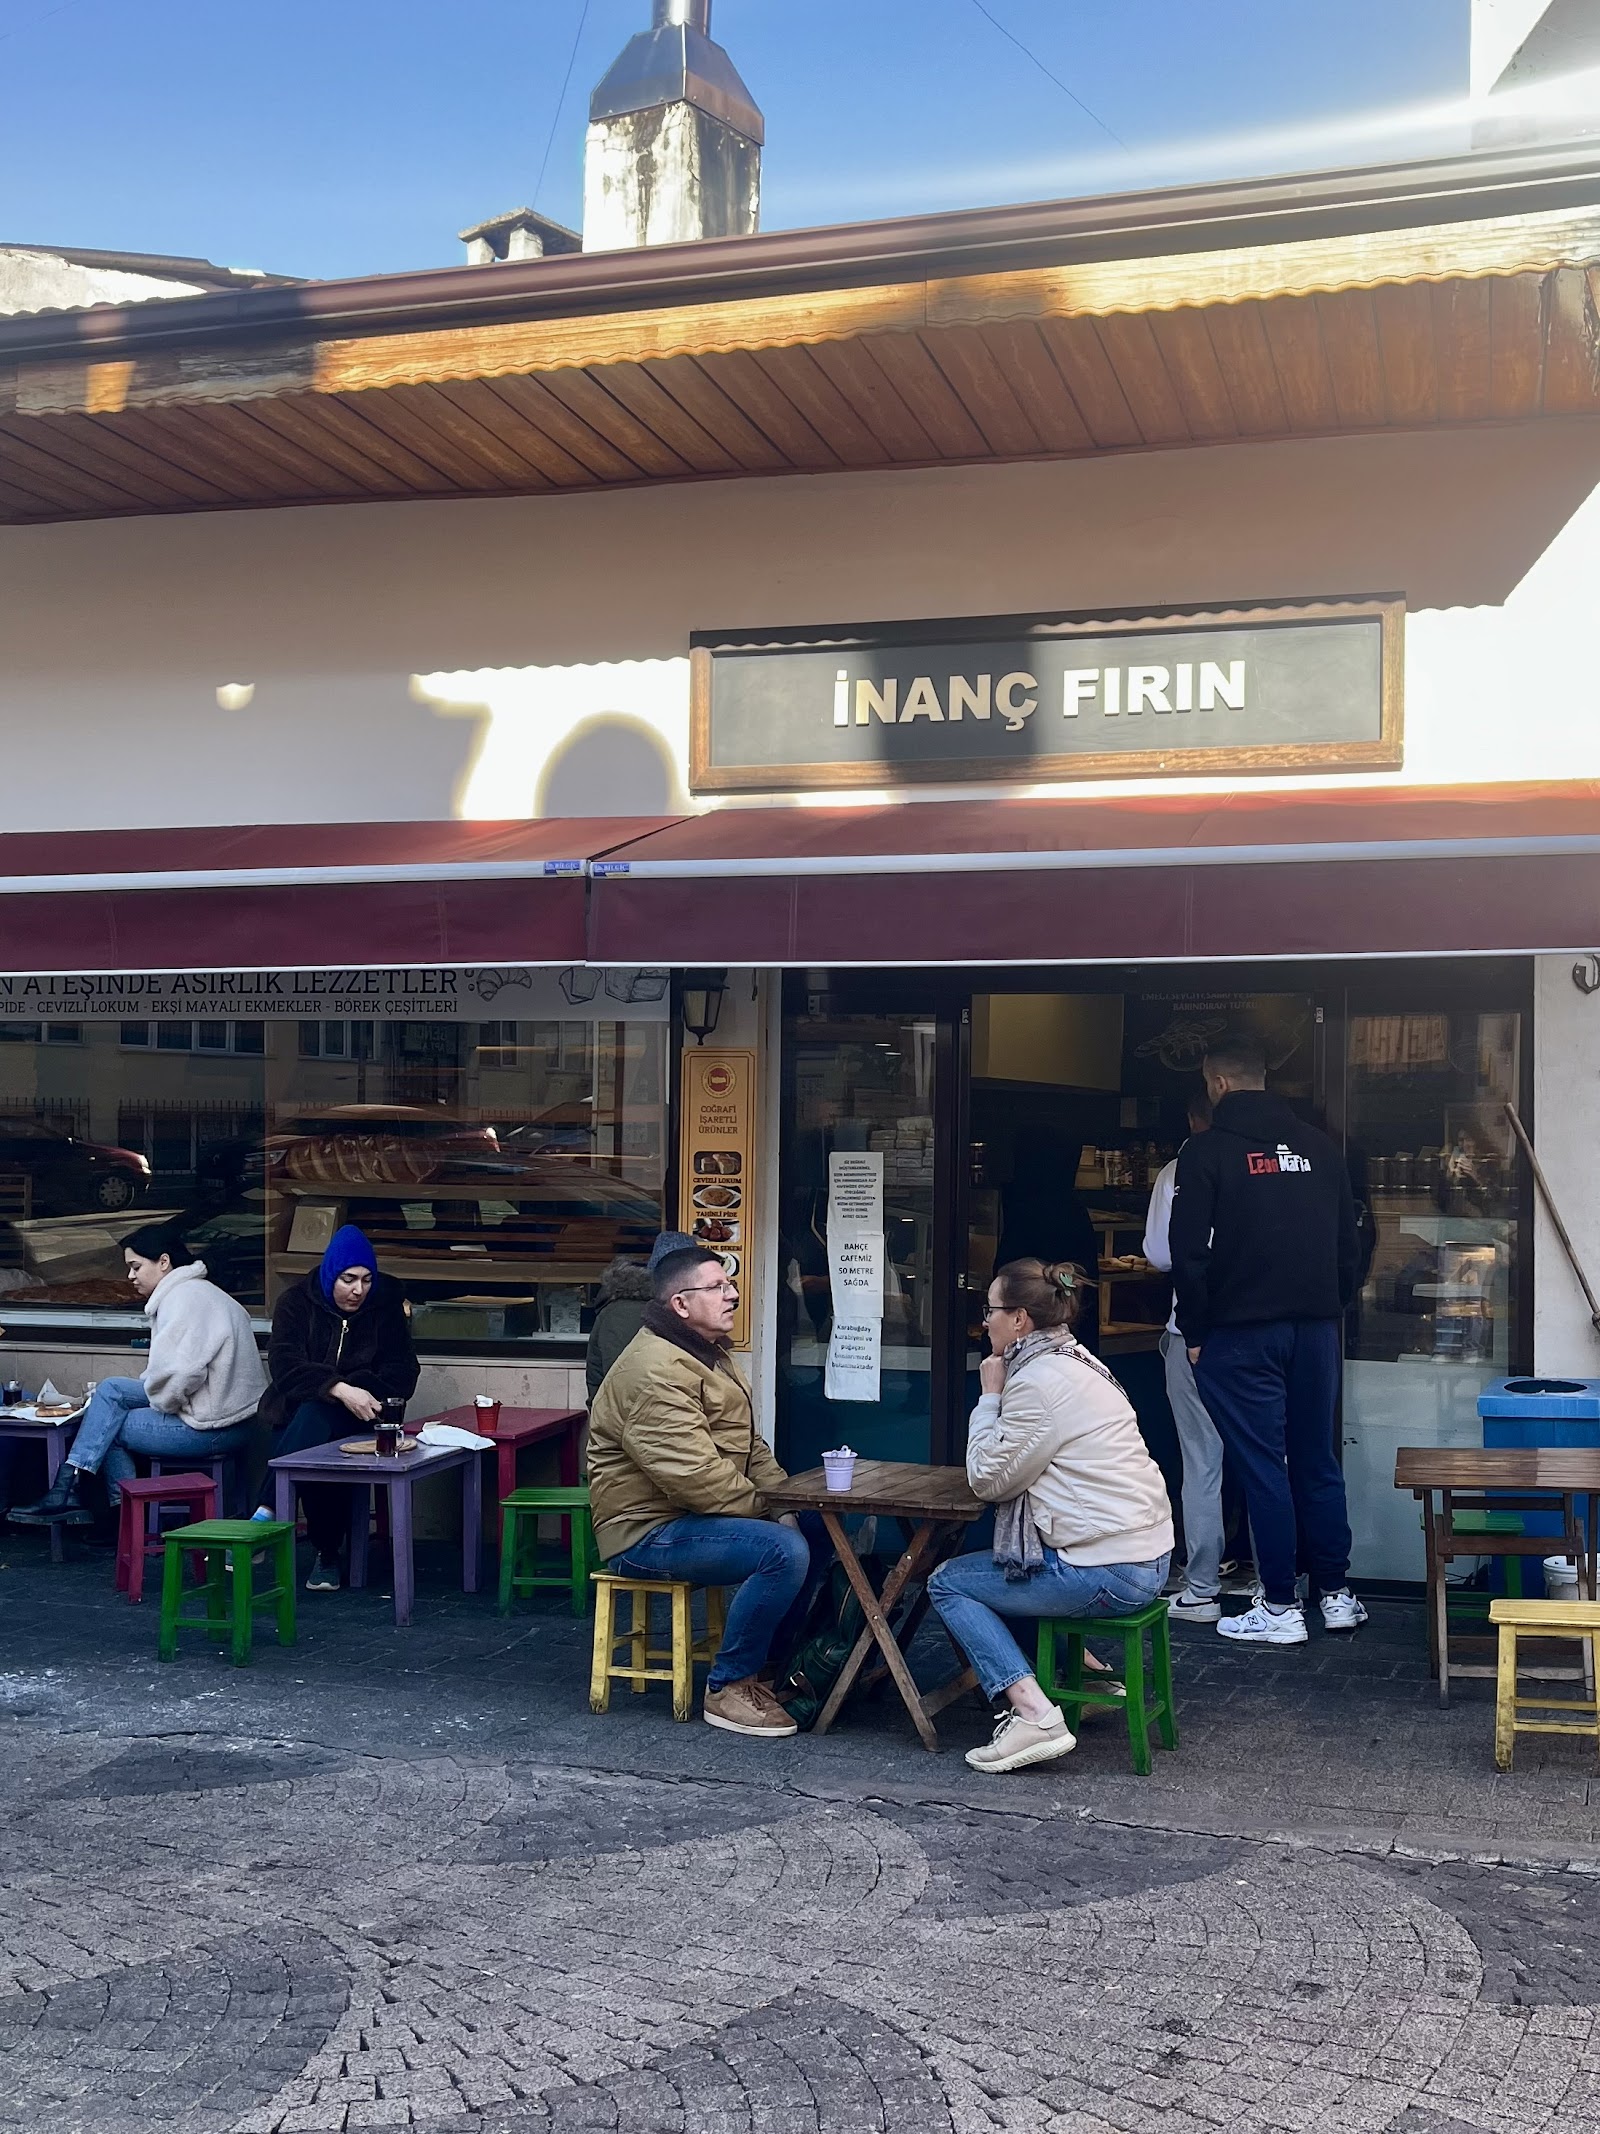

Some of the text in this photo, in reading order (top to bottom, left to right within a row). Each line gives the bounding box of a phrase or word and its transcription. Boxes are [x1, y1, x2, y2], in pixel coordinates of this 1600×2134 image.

[834, 660, 1246, 731] İNANÇ FIRIN
[171, 972, 283, 994] ASIRLIK
[292, 970, 457, 994] LEZZETLER
[37, 999, 87, 1013] CEVİZLİ
[91, 1001, 139, 1013] LOKUM
[152, 999, 182, 1015] EKŞİ
[185, 1001, 240, 1013] MAYALI
[245, 1000, 322, 1013] EKMEKLER
[335, 998, 381, 1013] BÖREK
[385, 997, 458, 1015] ÇEŞİTLERİ
[701, 1104, 736, 1113] COĞRAFİ
[700, 1114, 737, 1124] İŞARETLİ
[699, 1125, 738, 1134] ÜRÜNLER
[844, 1243, 868, 1251] BAHÇE
[840, 1254, 872, 1262] CAFEMİZ
[843, 1278, 869, 1286] SAĞDA
